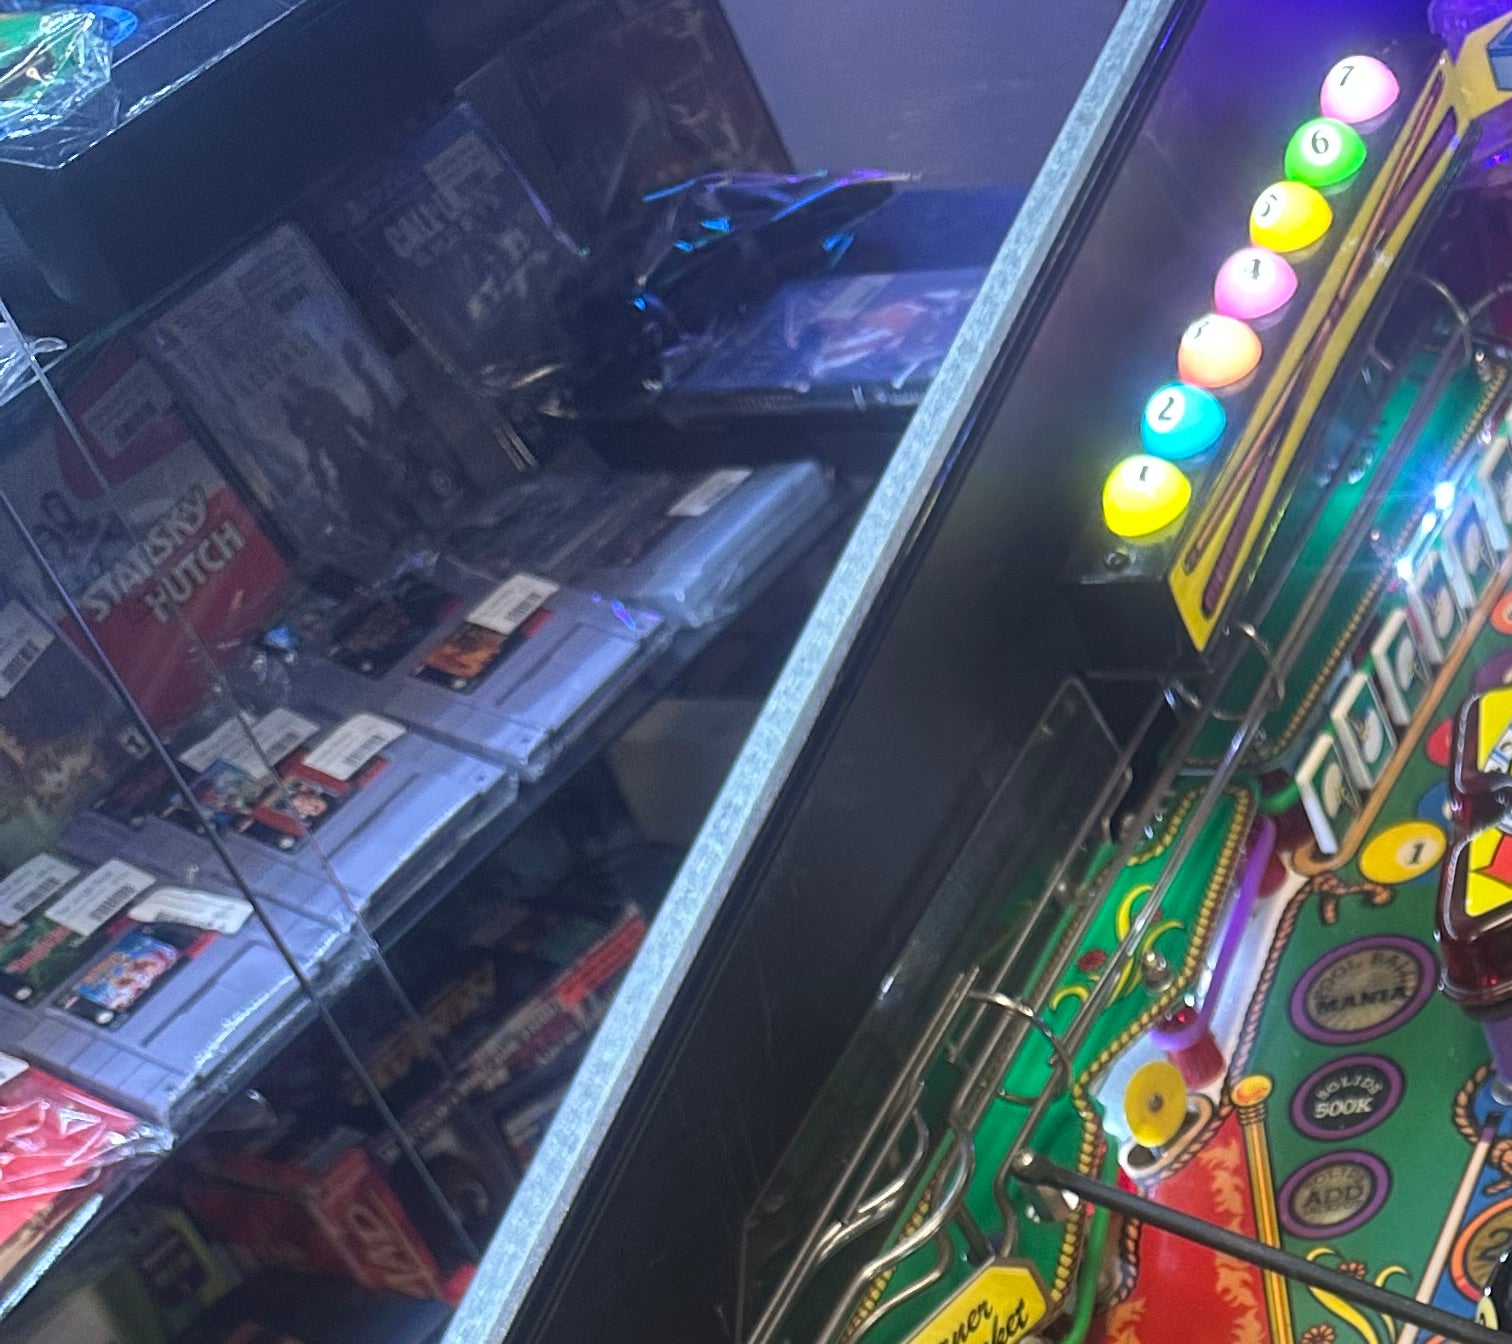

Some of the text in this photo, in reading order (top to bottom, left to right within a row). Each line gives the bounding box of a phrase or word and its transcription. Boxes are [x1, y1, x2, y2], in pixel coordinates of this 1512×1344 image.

[1338, 66, 1355, 88] 7
[1310, 131, 1329, 155] 6
[1316, 1075, 1384, 1102] SOLIDS
[1314, 1096, 1375, 1120] 500K
